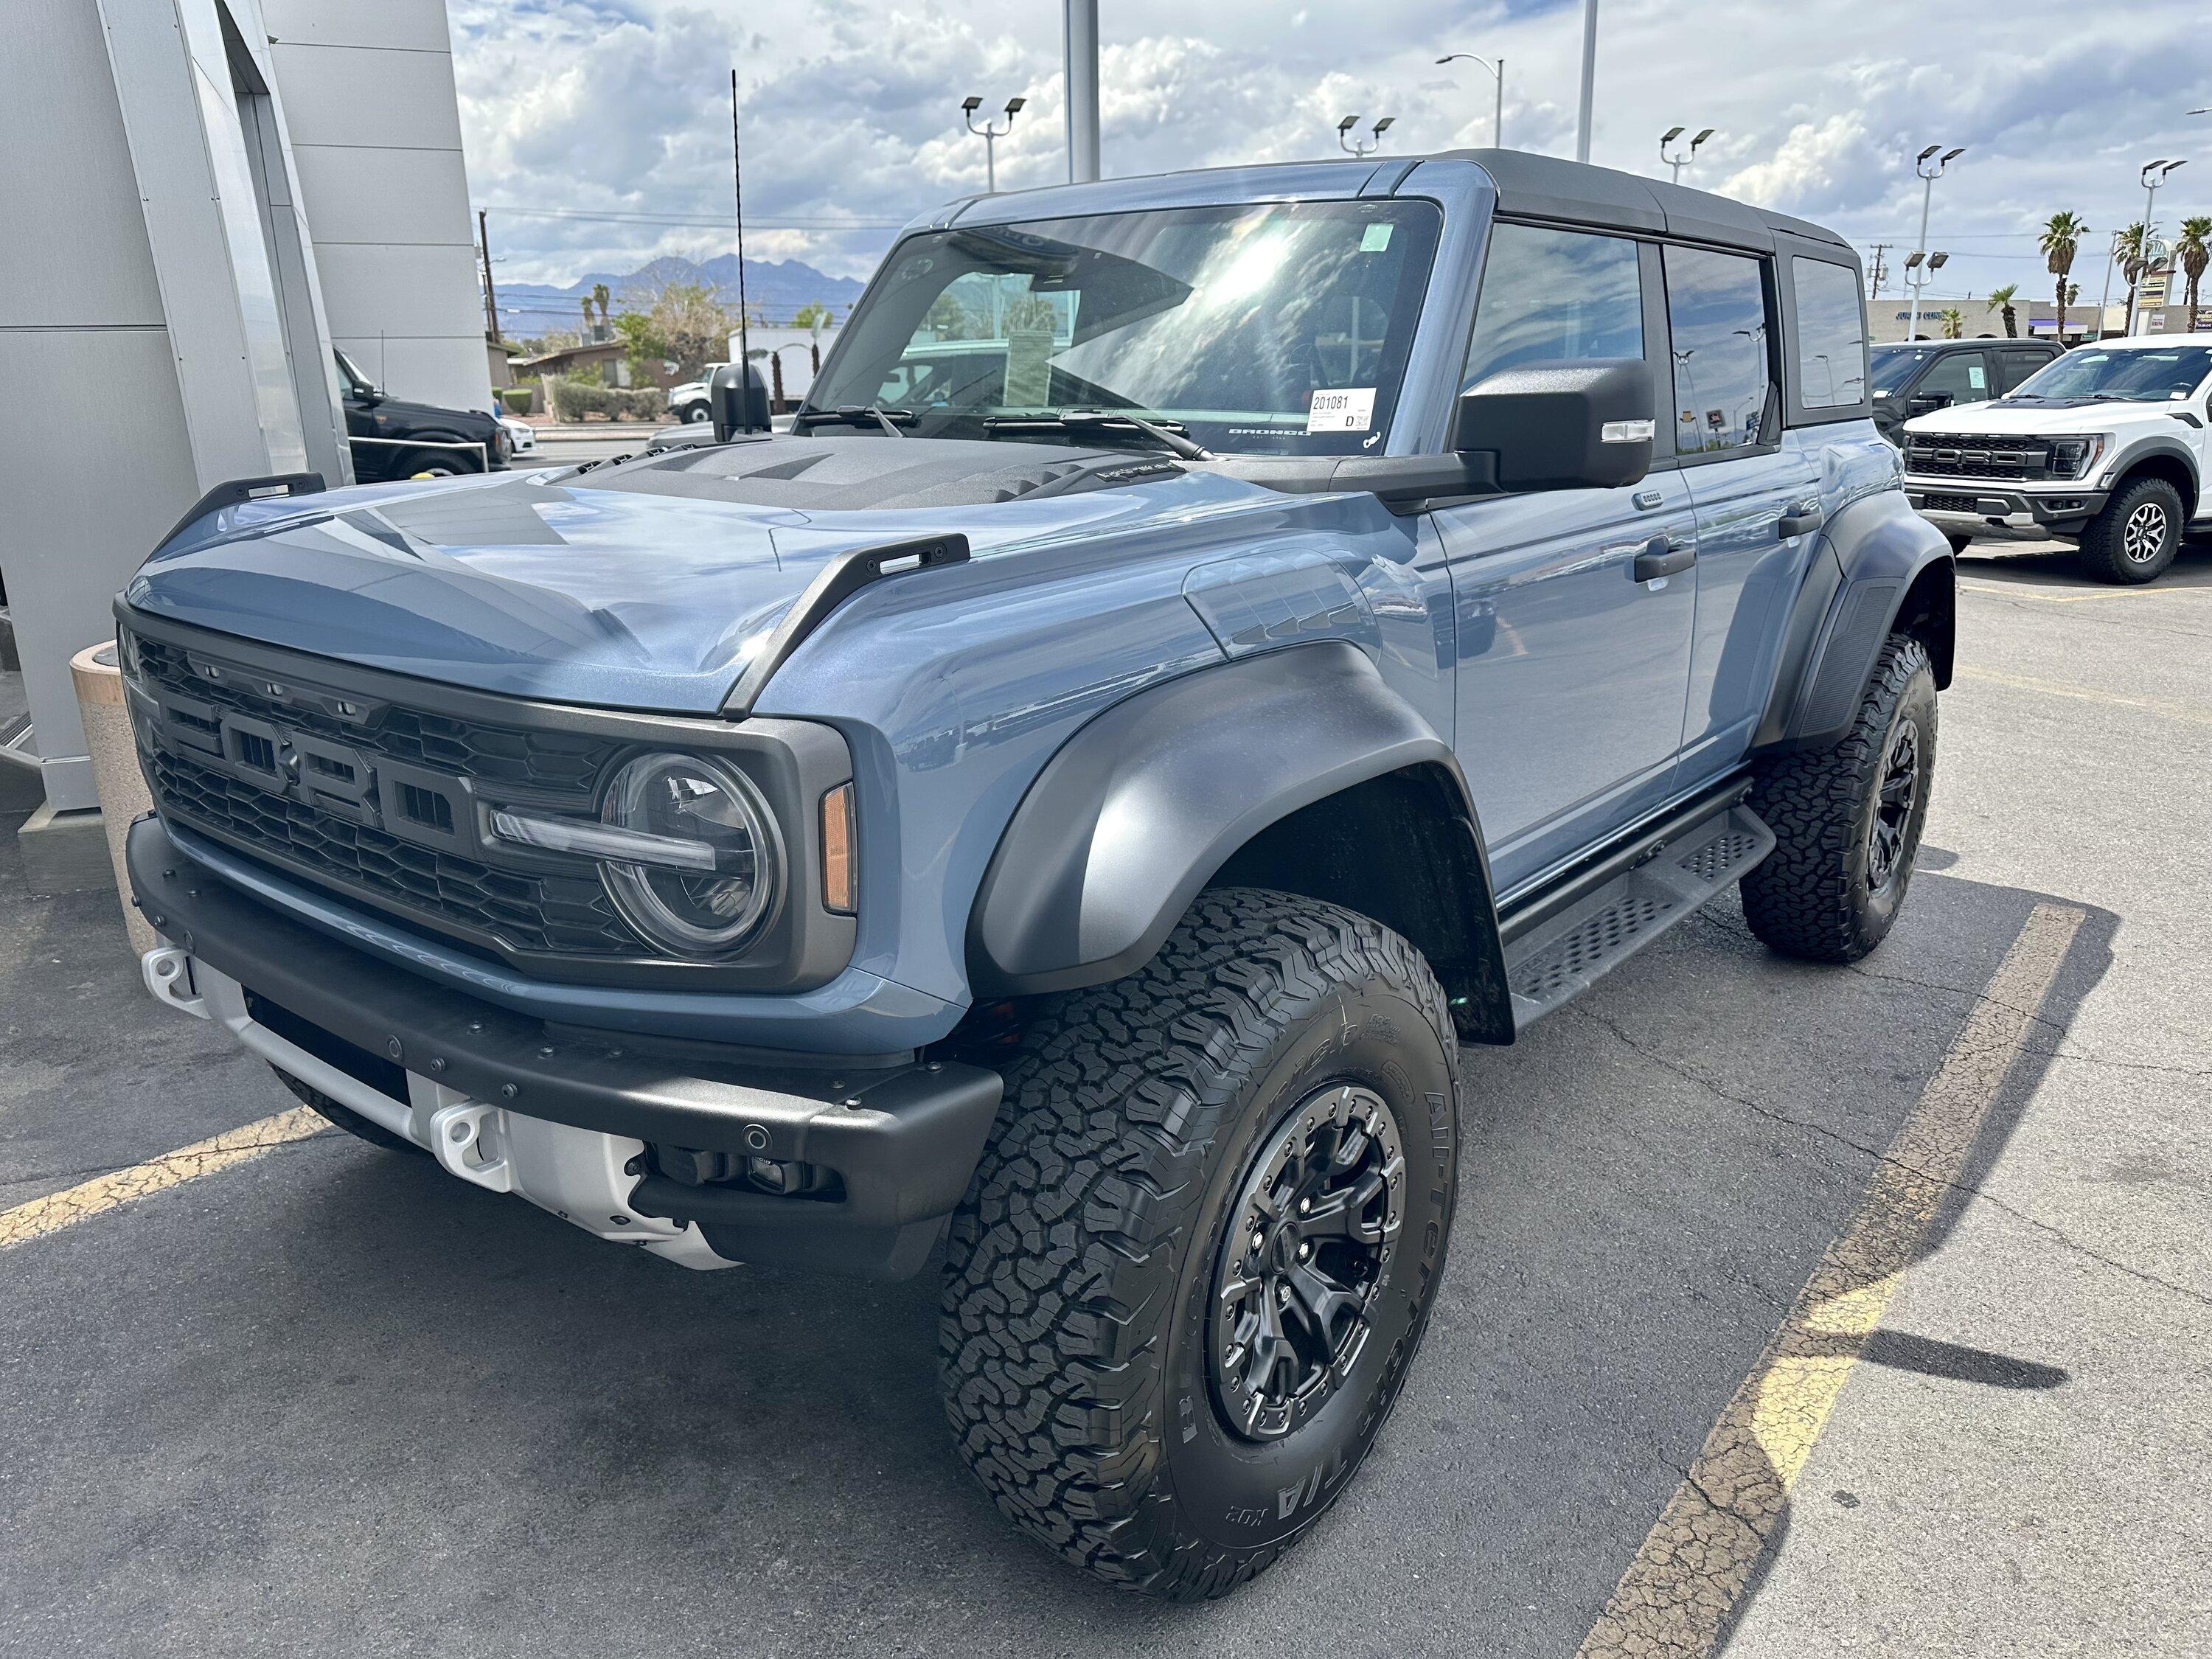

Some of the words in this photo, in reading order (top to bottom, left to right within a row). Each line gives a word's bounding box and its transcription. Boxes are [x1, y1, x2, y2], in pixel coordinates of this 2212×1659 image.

[1313, 395, 1349, 409] 201081
[1346, 416, 1354, 427] D
[1908, 447, 2026, 467] FORD
[158, 689, 484, 863] FORD
[1356, 1091, 1450, 1438] All-Terrain
